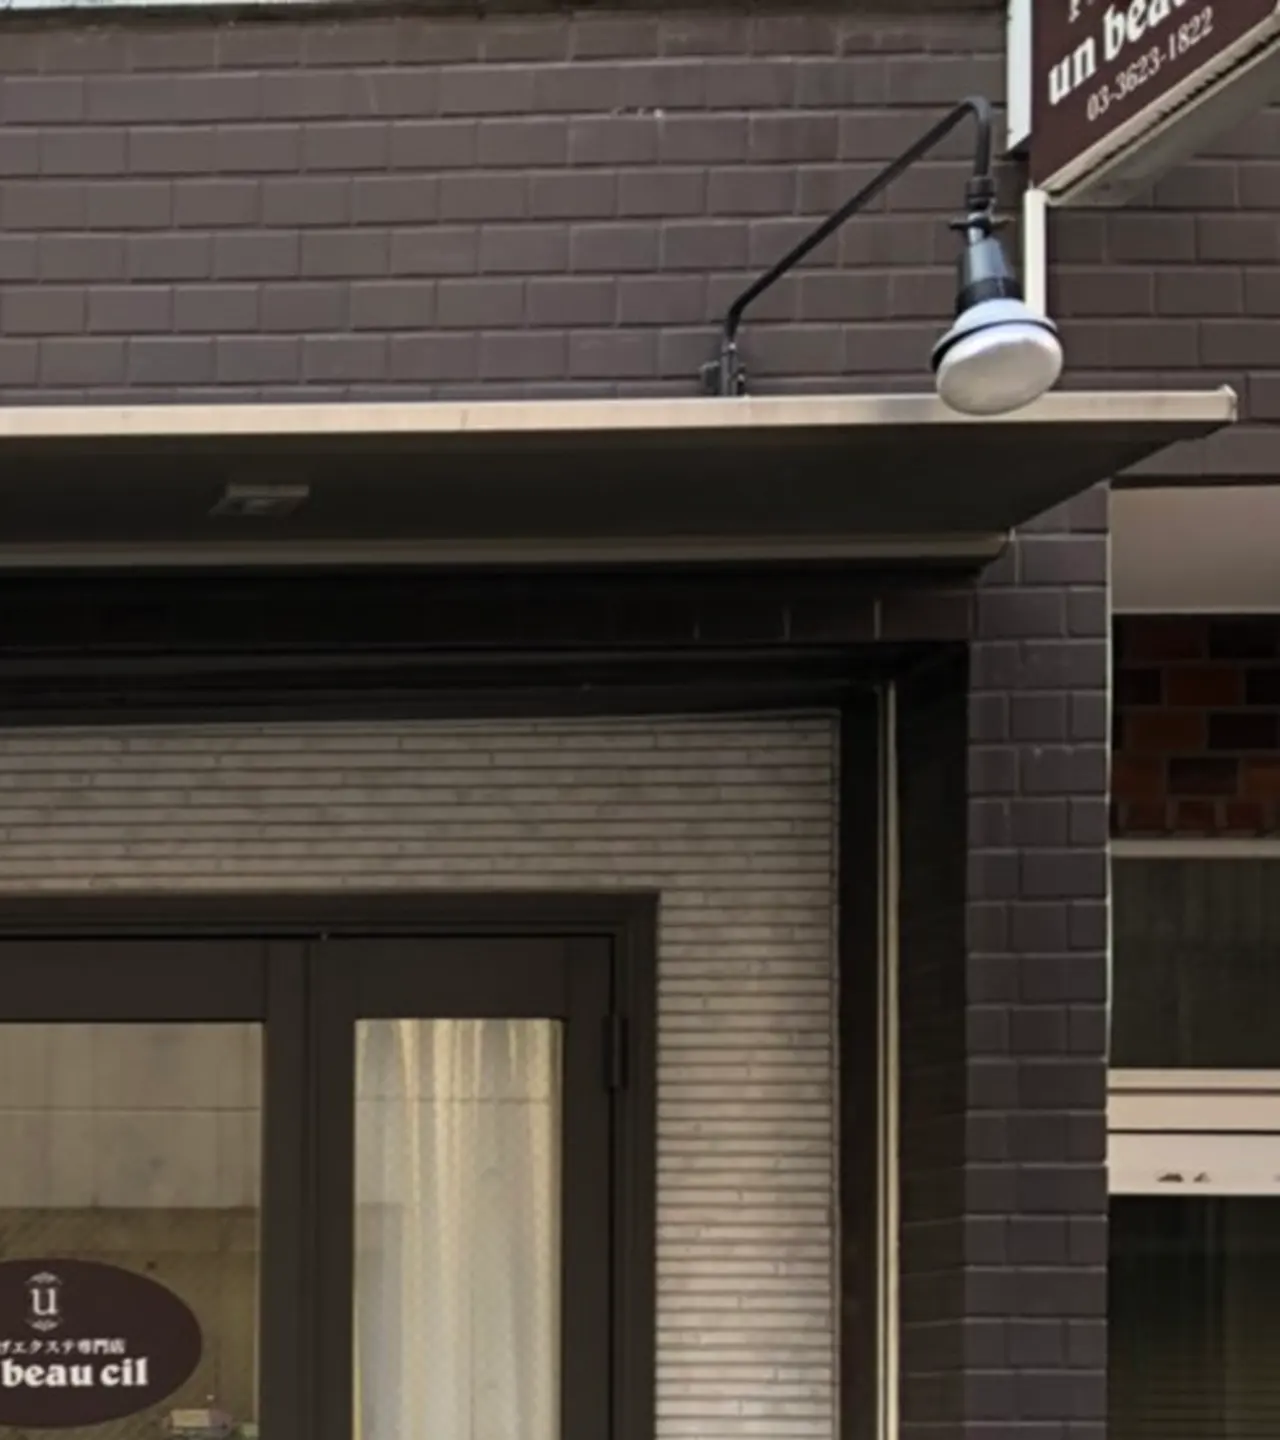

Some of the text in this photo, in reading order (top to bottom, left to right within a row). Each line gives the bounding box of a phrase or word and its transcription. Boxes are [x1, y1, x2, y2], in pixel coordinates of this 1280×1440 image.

[1048, 0, 1186, 106] un bea
[1086, 5, 1214, 122] 03-3623-1822
[0, 1358, 94, 1388] beau
[100, 1356, 149, 1387] cil
